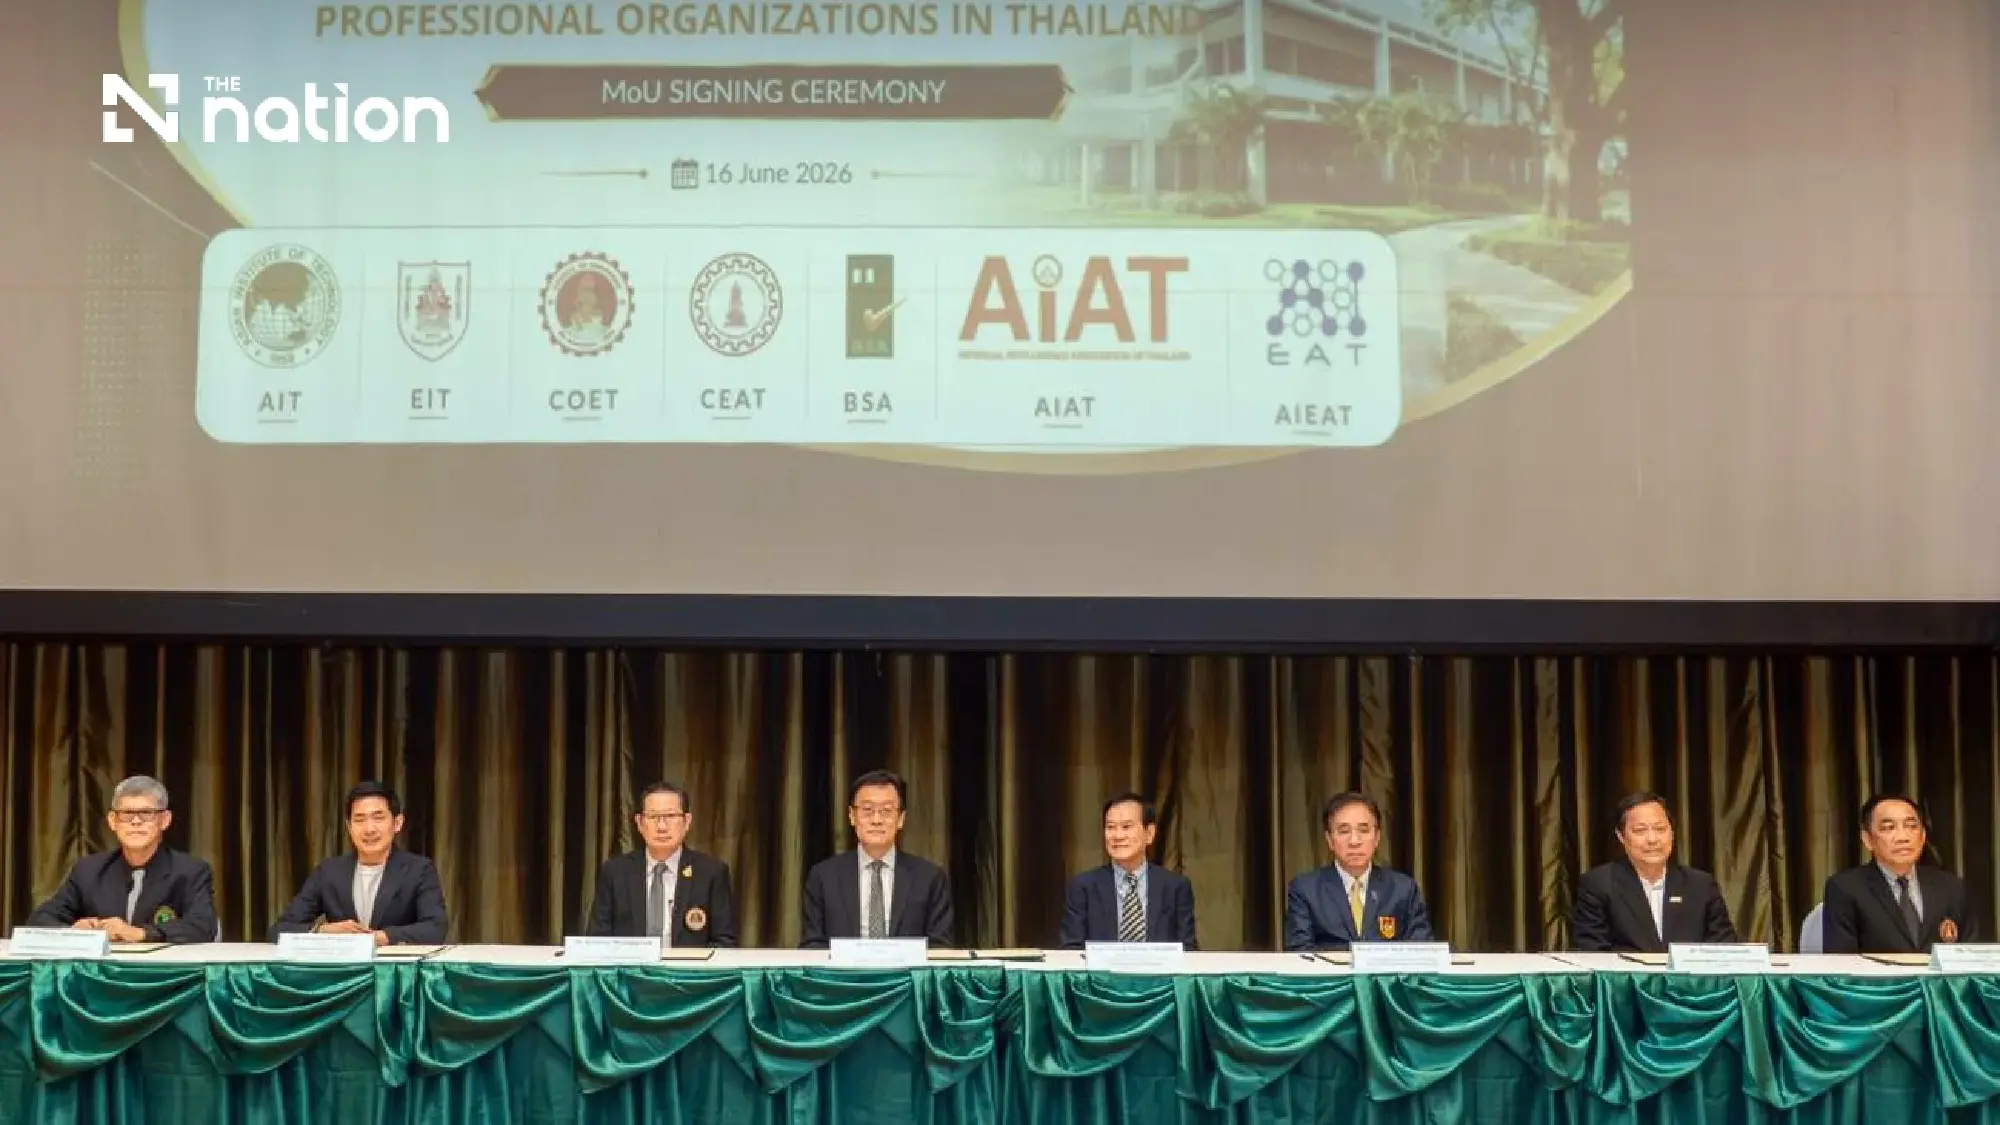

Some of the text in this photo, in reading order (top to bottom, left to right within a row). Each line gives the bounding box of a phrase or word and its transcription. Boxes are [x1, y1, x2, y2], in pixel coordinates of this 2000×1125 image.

[315, 3, 1206, 37] PROFESSIONAL ORGANIZATIONS IN THAILAND
[602, 79, 947, 104] MoU SIGNING CEREMONY
[706, 162, 852, 184] 16 June 2026
[258, 389, 302, 412] AIT
[411, 388, 451, 410] EIT
[549, 389, 619, 411] COET
[701, 388, 767, 410] CEAT
[844, 391, 893, 413] BSA
[1034, 396, 1096, 418] AIAT
[1274, 403, 1353, 426] AIEAT
